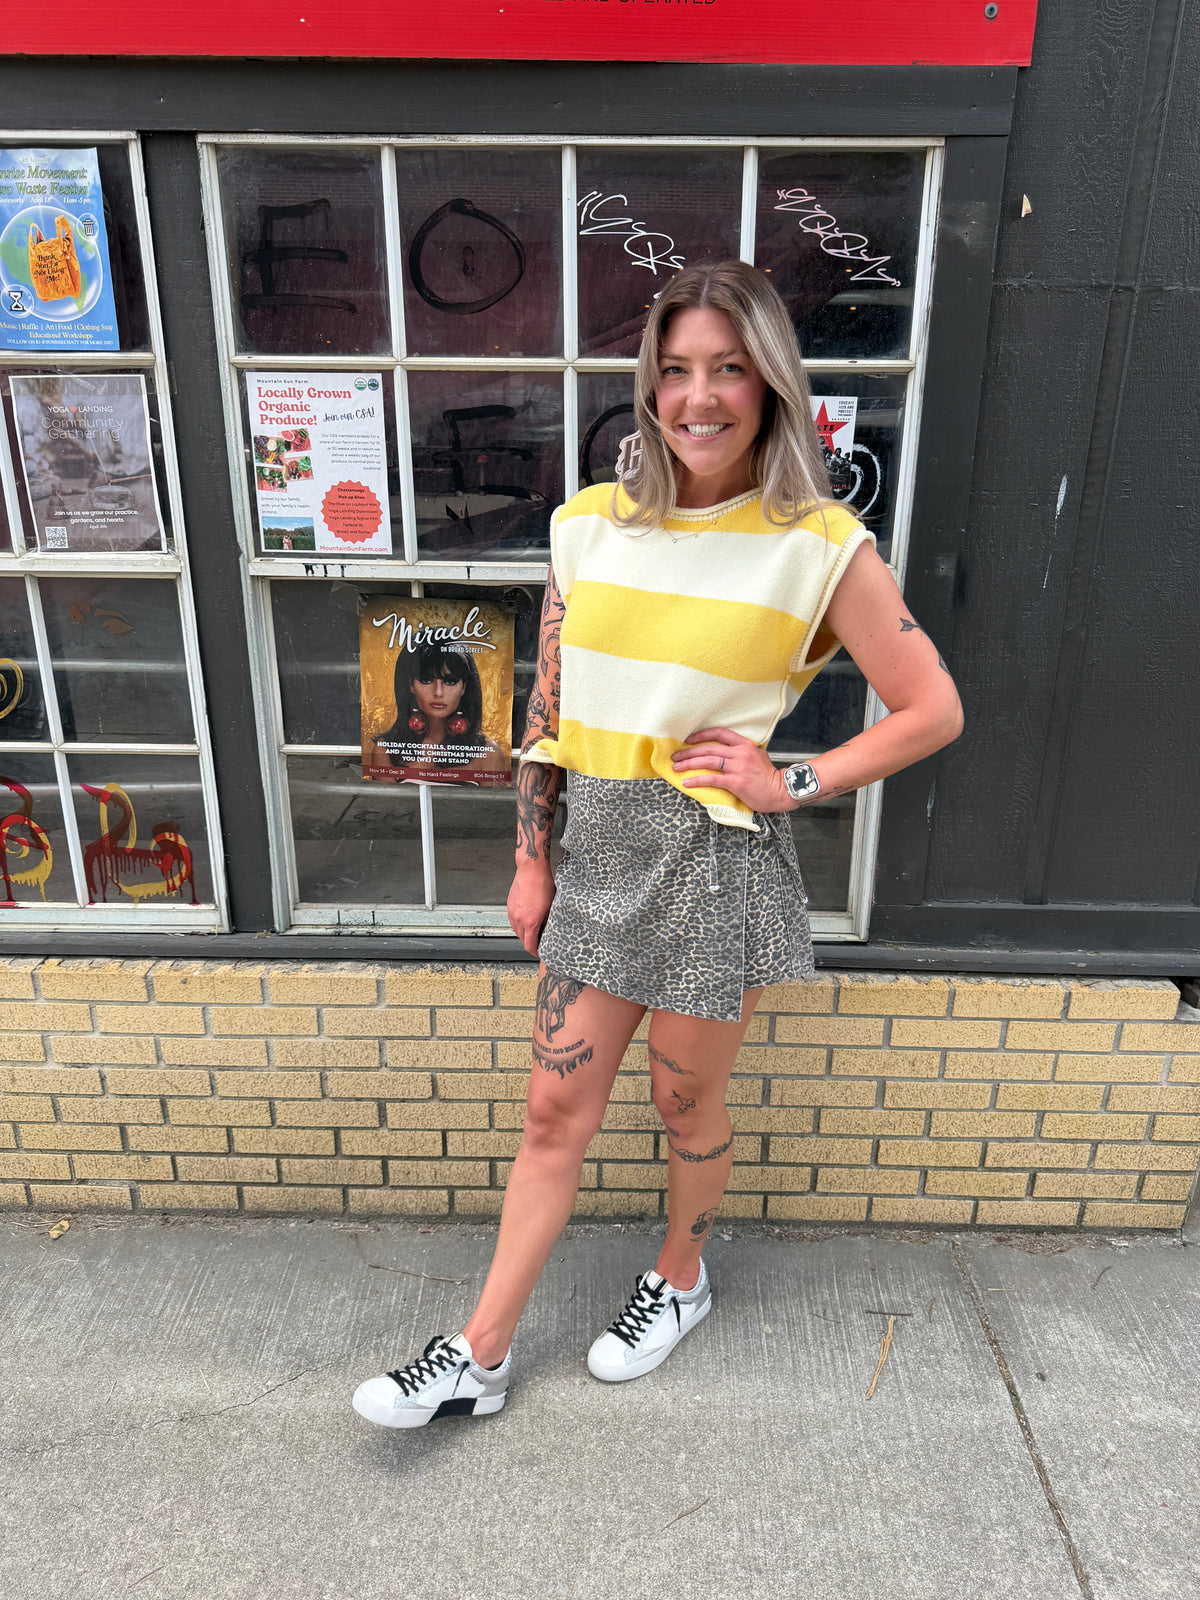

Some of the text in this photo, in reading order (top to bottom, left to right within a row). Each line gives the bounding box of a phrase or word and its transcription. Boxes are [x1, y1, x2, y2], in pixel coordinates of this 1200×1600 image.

[15, 181, 48, 195] Waste
[50, 182, 91, 196] Festival
[37, 253, 59, 263] Thank
[34, 267, 67, 280] Not Using
[45, 274, 60, 284] Me!
[58, 323, 73, 331] Food
[76, 323, 100, 332] Clothing
[29, 331, 61, 339] Educational
[257, 387, 352, 400] Locally Grown
[78, 405, 113, 413] LANDING
[258, 401, 311, 414] Organic
[260, 414, 317, 426] Produce!
[323, 413, 339, 422] Join
[355, 406, 375, 419] CSA!
[41, 417, 124, 430] Community
[48, 429, 120, 441] Gathering
[372, 606, 492, 653] Miracle
[407, 743, 446, 751] COCKTAILS,
[447, 744, 496, 753] DECORATIONS,
